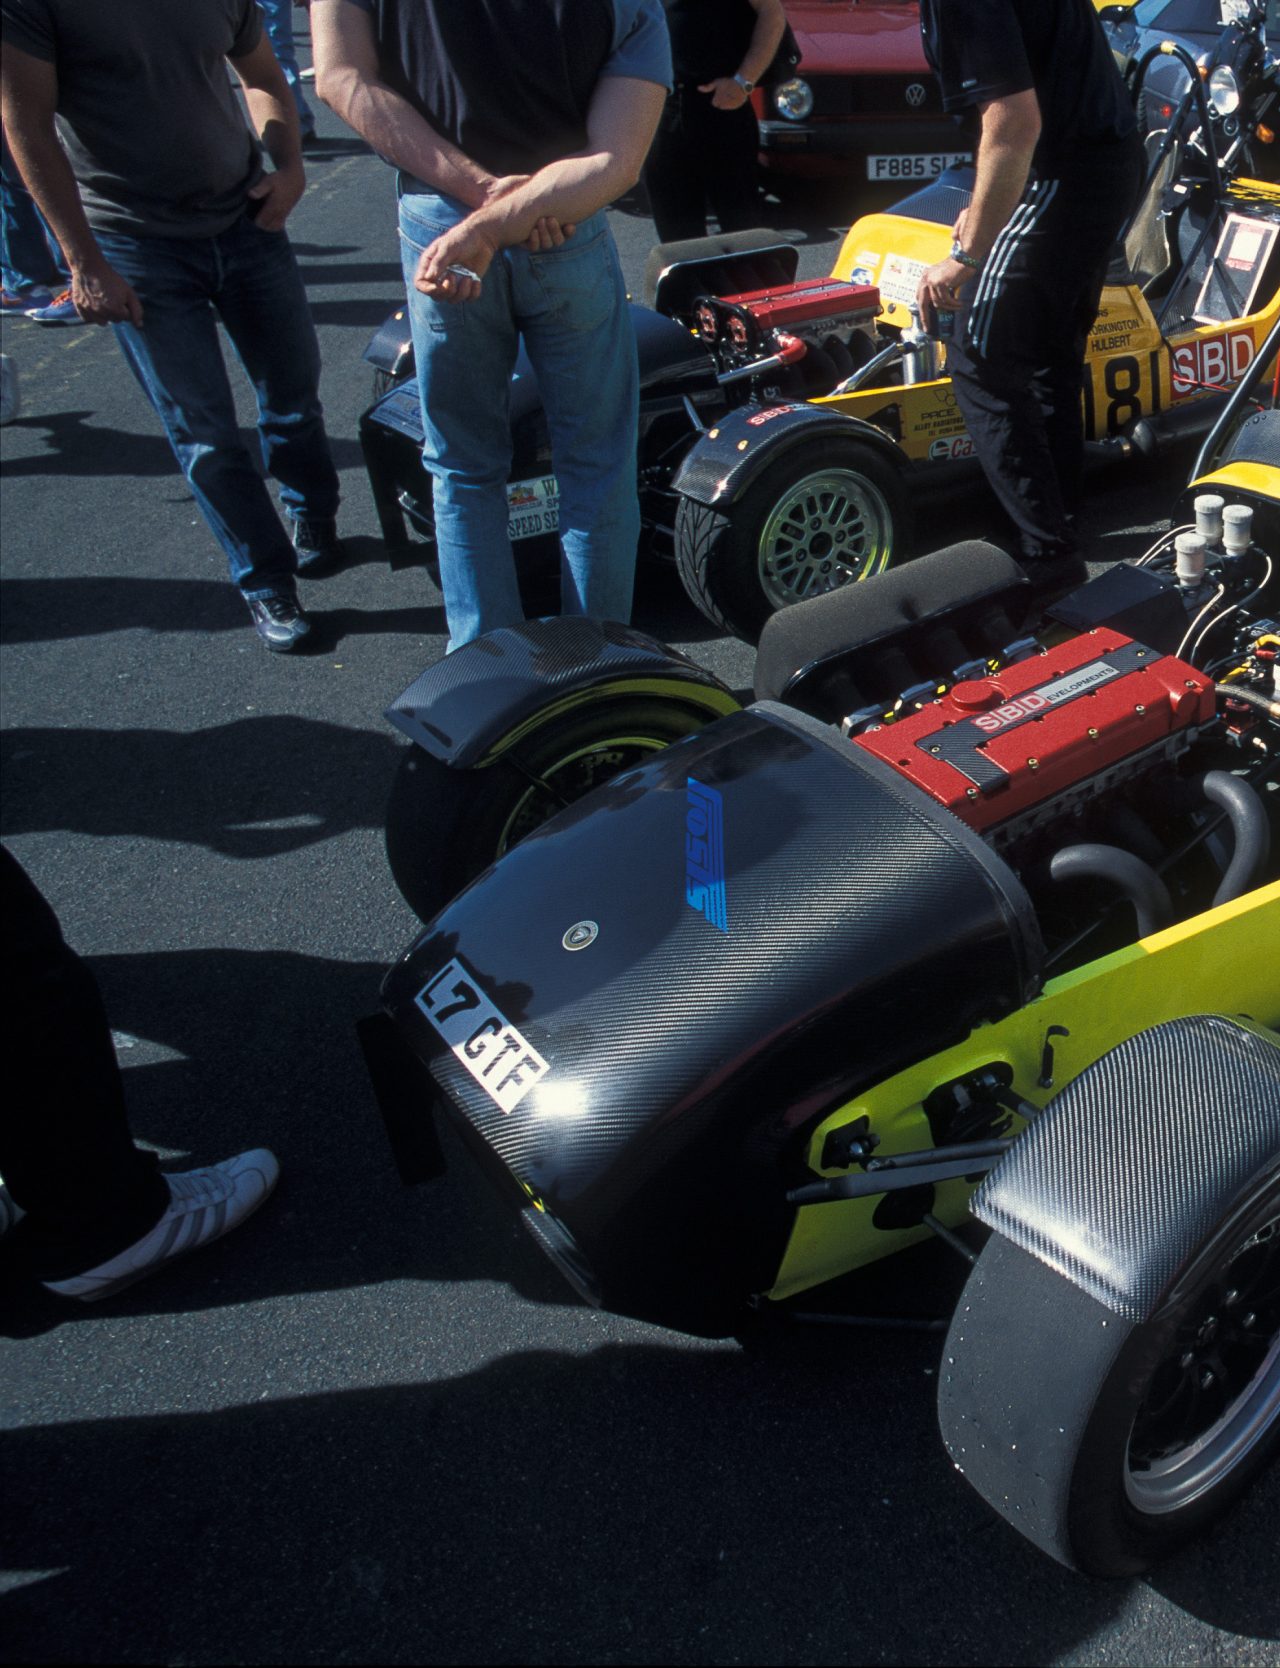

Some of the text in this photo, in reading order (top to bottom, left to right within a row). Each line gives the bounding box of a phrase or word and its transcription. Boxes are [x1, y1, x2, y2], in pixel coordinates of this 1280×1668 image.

[875, 158, 925, 177] F885
[1091, 333, 1131, 353] HULBERT
[1173, 334, 1255, 393] SBD
[750, 406, 792, 425] SBD
[951, 438, 974, 458] Ca
[507, 509, 559, 538] SPEED SE
[975, 667, 1115, 730] SBD EVELOPMENTS
[463, 1016, 542, 1093] GTF
